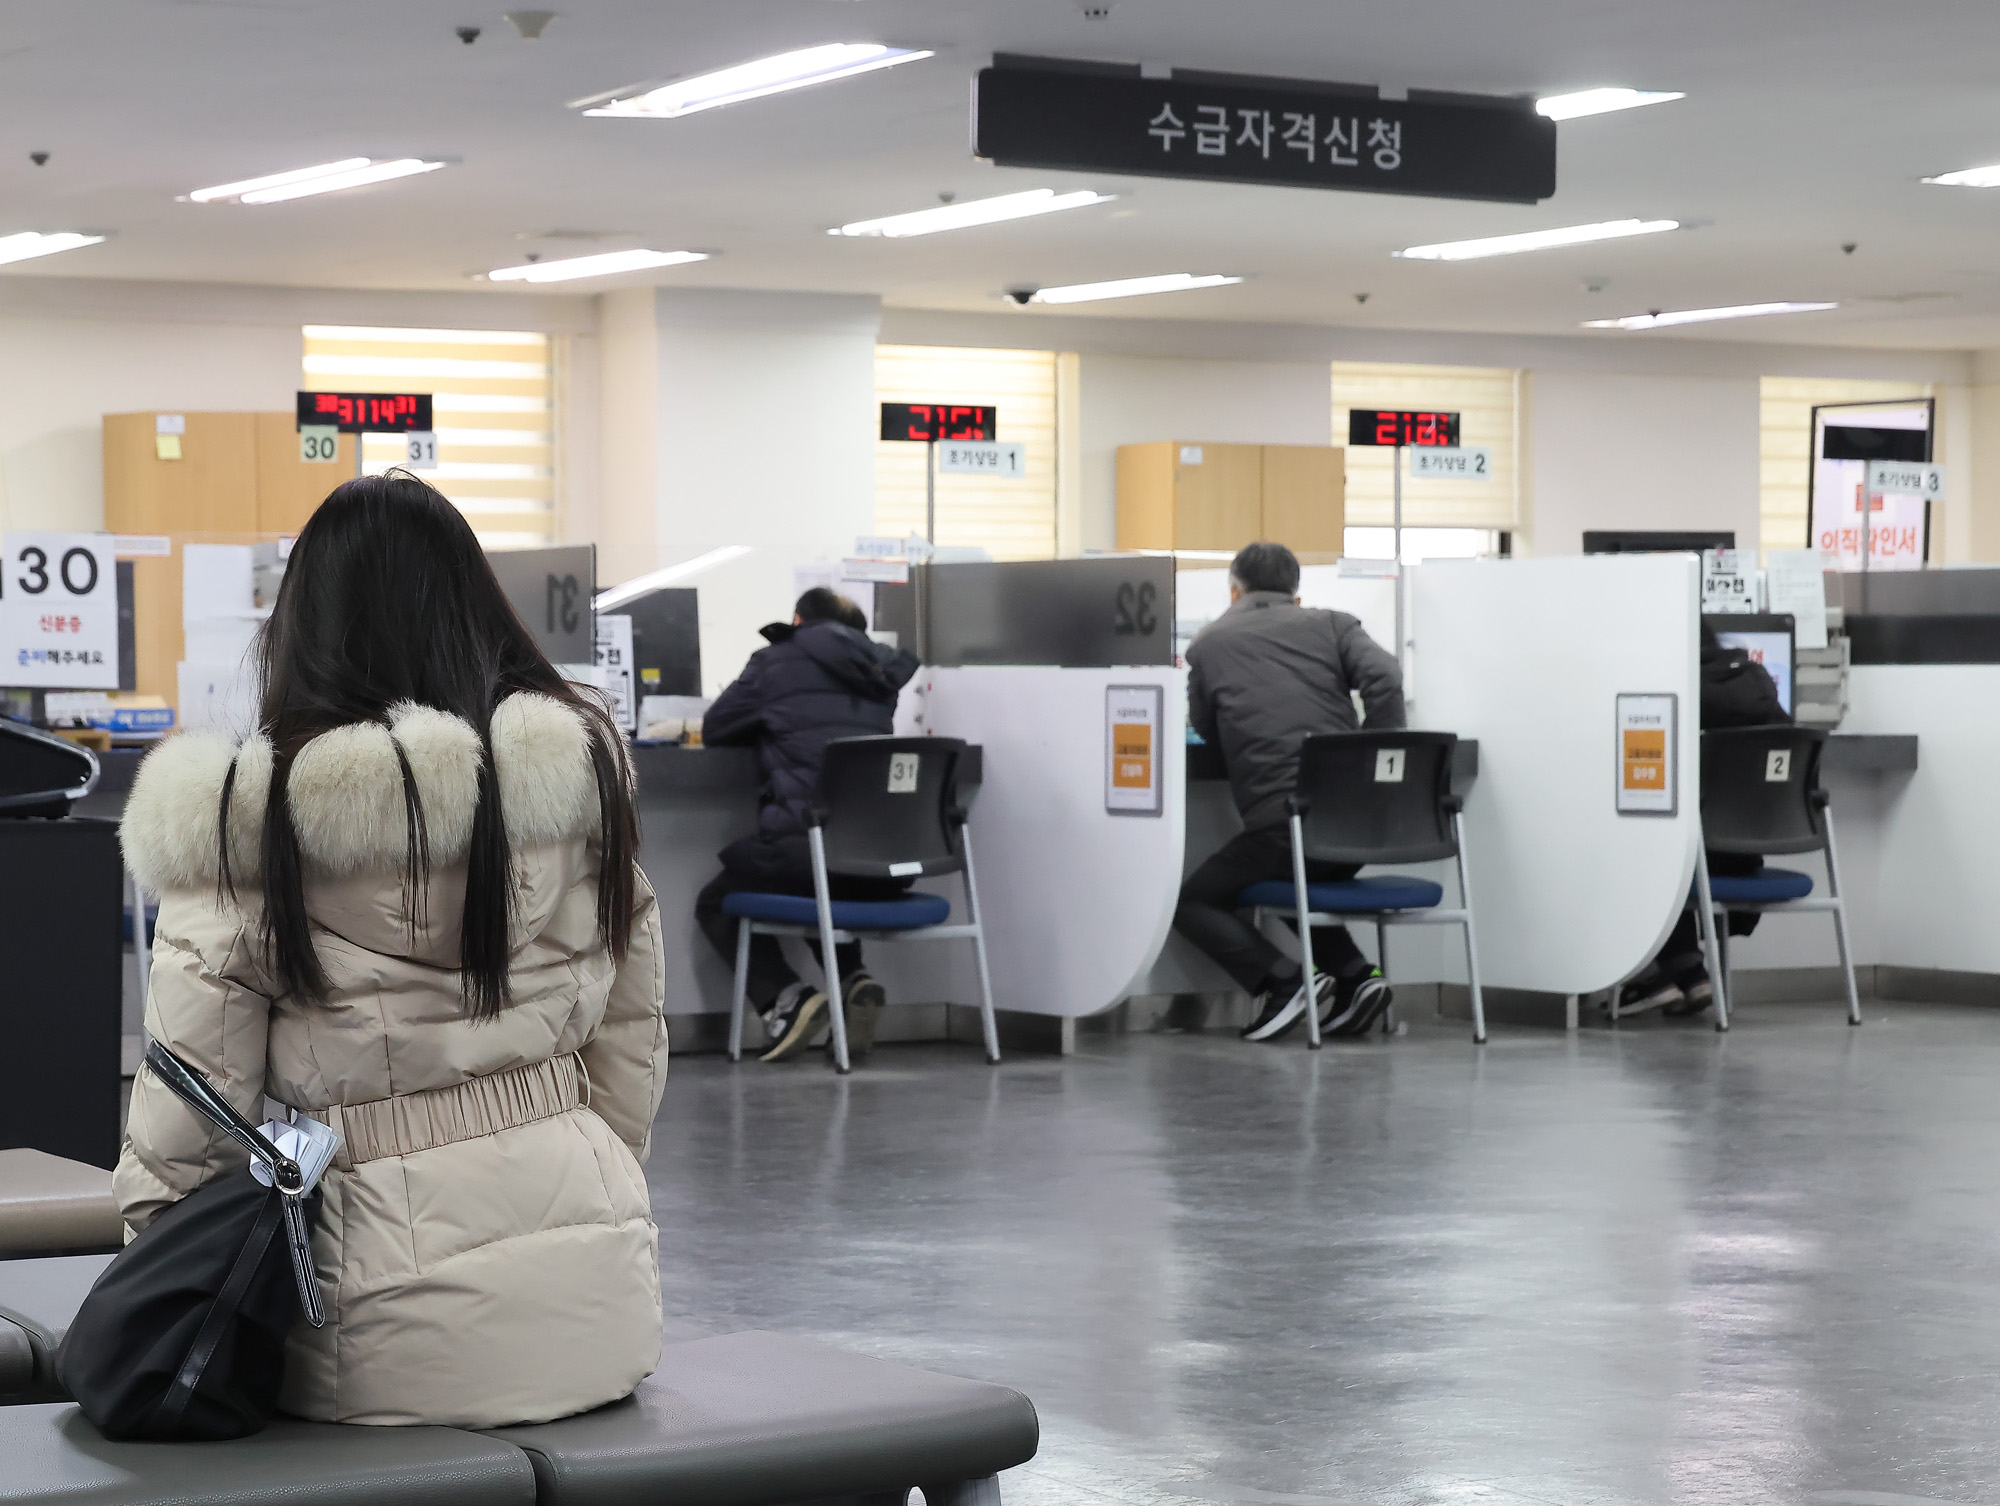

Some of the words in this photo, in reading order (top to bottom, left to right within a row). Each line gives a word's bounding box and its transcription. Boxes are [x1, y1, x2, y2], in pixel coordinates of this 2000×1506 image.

[1146, 102, 1402, 171] 수급자격신청
[304, 436, 335, 460] 30
[410, 441, 434, 461] 31
[1008, 450, 1016, 471] 1
[1420, 454, 1467, 475] 초기상담
[1475, 453, 1486, 475] 2
[1928, 472, 1940, 493] 3
[18, 546, 99, 595] 30
[893, 761, 914, 781] 31
[1386, 756, 1394, 775] 1
[1774, 756, 1784, 775] 2
